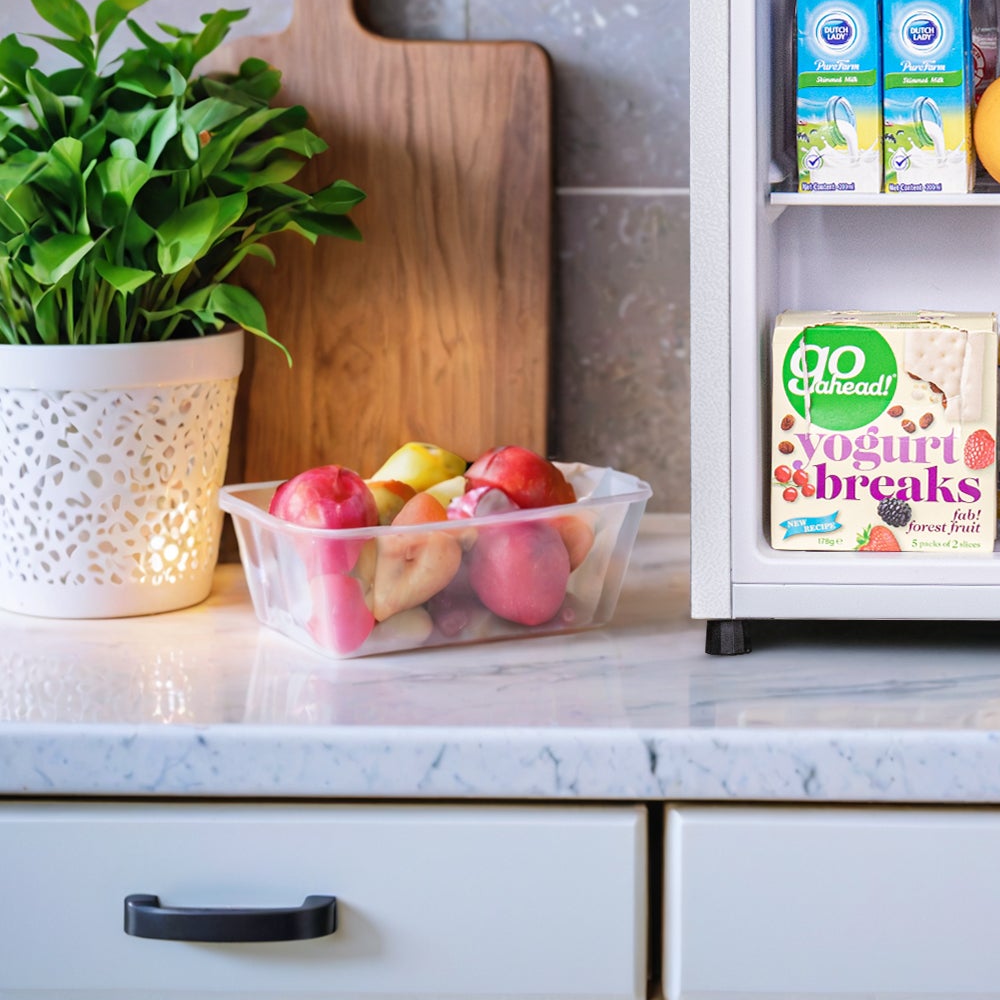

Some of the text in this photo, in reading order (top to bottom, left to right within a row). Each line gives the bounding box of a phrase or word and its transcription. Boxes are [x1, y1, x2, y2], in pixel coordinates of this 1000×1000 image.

[824, 26, 849, 34] DUTCH
[788, 344, 866, 396] go
[814, 373, 892, 396] ahead!
[792, 426, 959, 471] yogurt
[814, 463, 982, 503] breaks
[953, 509, 982, 522] fab!
[787, 519, 806, 528] NEW
[804, 522, 836, 533] RECIPE
[906, 520, 981, 535] forest fruit
[911, 539, 981, 549] 5 packs of 2 slices
